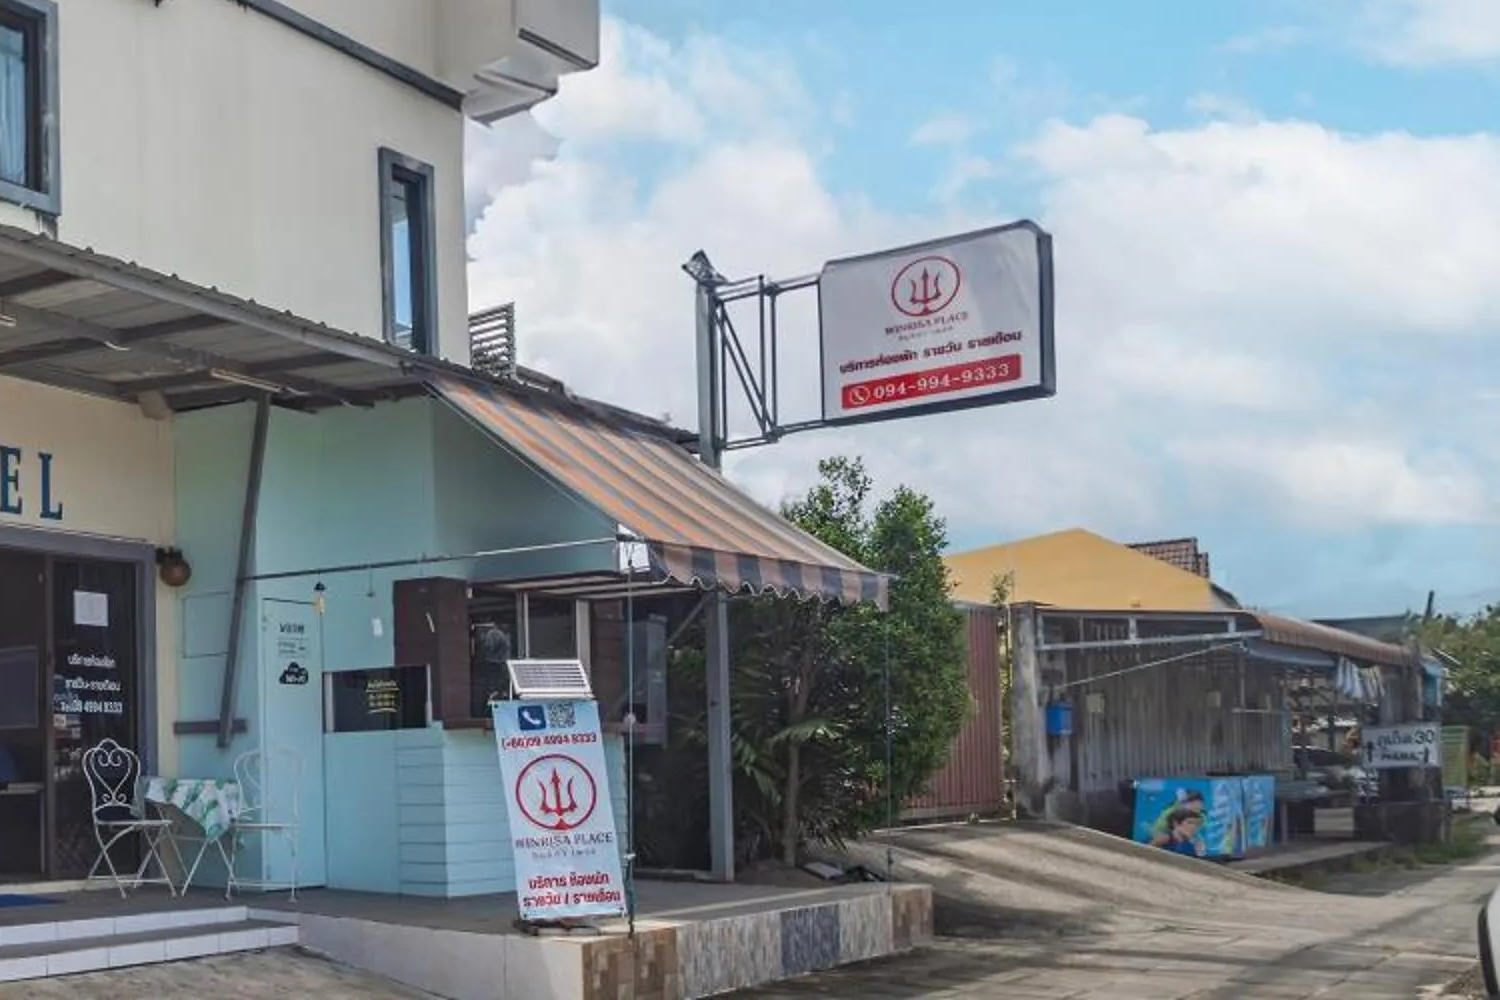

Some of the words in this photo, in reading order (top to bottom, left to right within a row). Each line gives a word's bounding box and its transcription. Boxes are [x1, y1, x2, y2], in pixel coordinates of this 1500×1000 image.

[934, 311, 969, 326] PLACE
[924, 340, 963, 359] รายวัน
[968, 330, 1022, 350] รายเดือน
[873, 363, 1010, 399] 094-994-9333
[516, 835, 571, 849] WINRISA
[573, 831, 613, 845] PLACE
